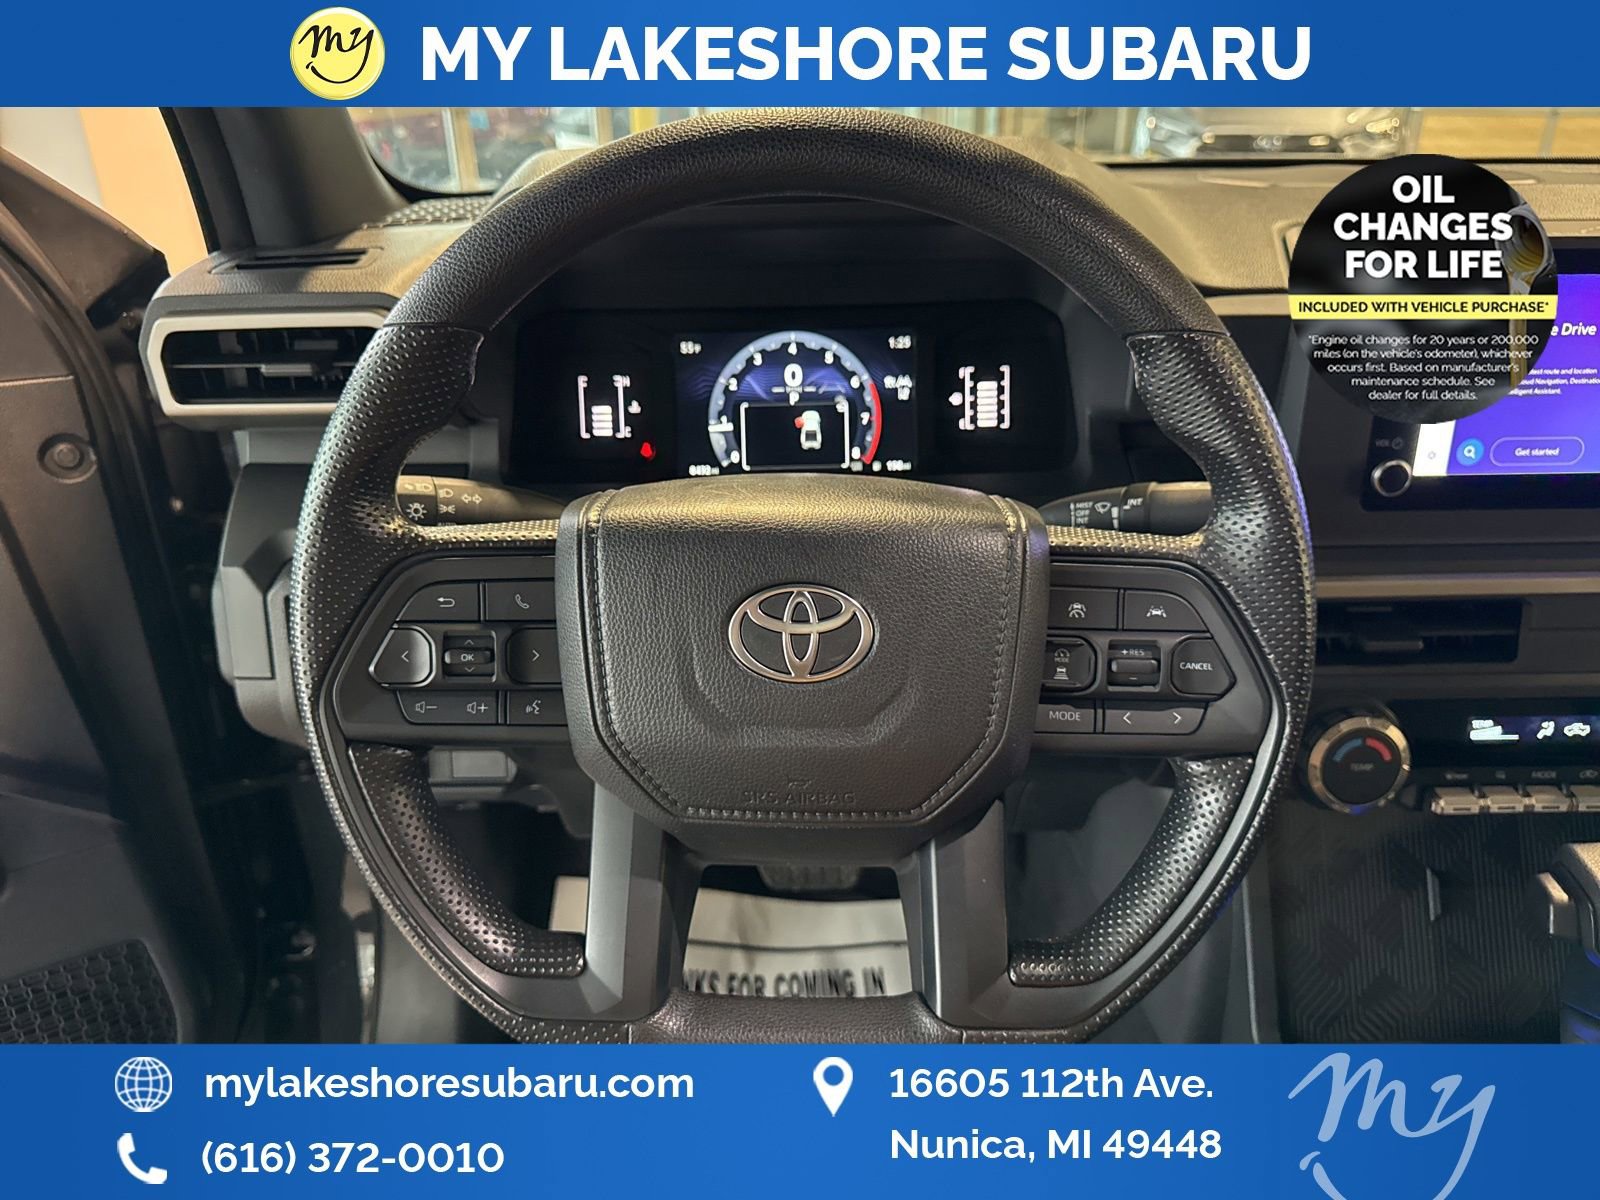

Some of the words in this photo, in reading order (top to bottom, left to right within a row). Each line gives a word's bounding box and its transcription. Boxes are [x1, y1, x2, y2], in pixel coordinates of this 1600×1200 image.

[1561, 322, 1597, 336] Drive
[784, 363, 803, 387] 0
[789, 391, 800, 406] P
[1514, 446, 1531, 457] Get
[1531, 446, 1560, 457] started
[1075, 509, 1090, 517] OFF
[461, 652, 475, 663] OK
[1179, 661, 1213, 671] CANCEL
[1049, 711, 1081, 721] MODE
[785, 792, 857, 806] AIRBAG
[727, 972, 766, 996] FOR
[774, 968, 856, 998] COMING
[862, 967, 886, 995] IN
